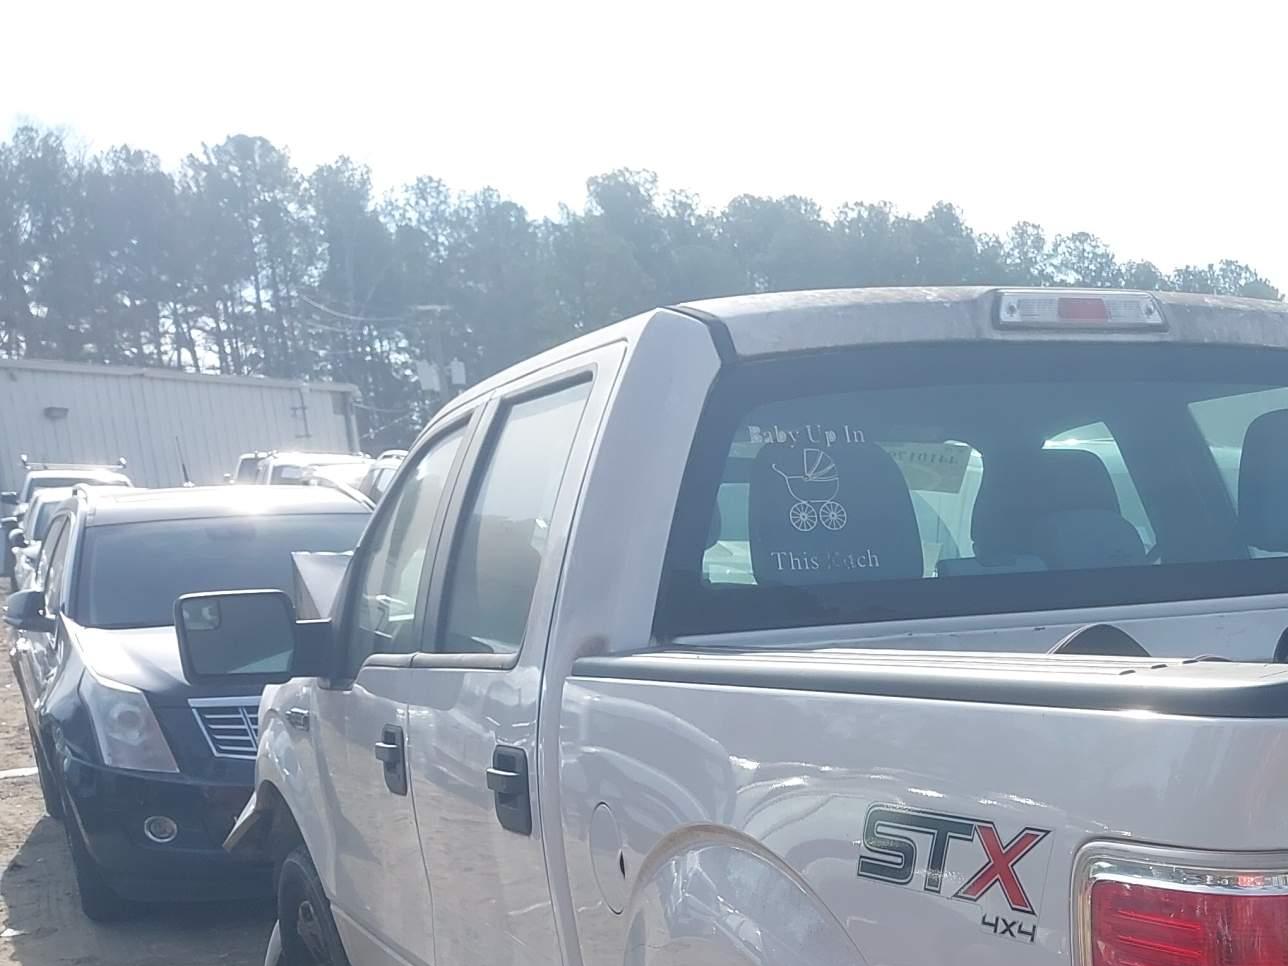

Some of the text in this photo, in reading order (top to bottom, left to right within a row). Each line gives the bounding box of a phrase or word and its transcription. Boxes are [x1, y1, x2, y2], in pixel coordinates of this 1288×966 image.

[805, 424, 838, 447] Up
[844, 424, 865, 443] In
[770, 548, 880, 571] This tch
[857, 801, 1051, 915] STX
